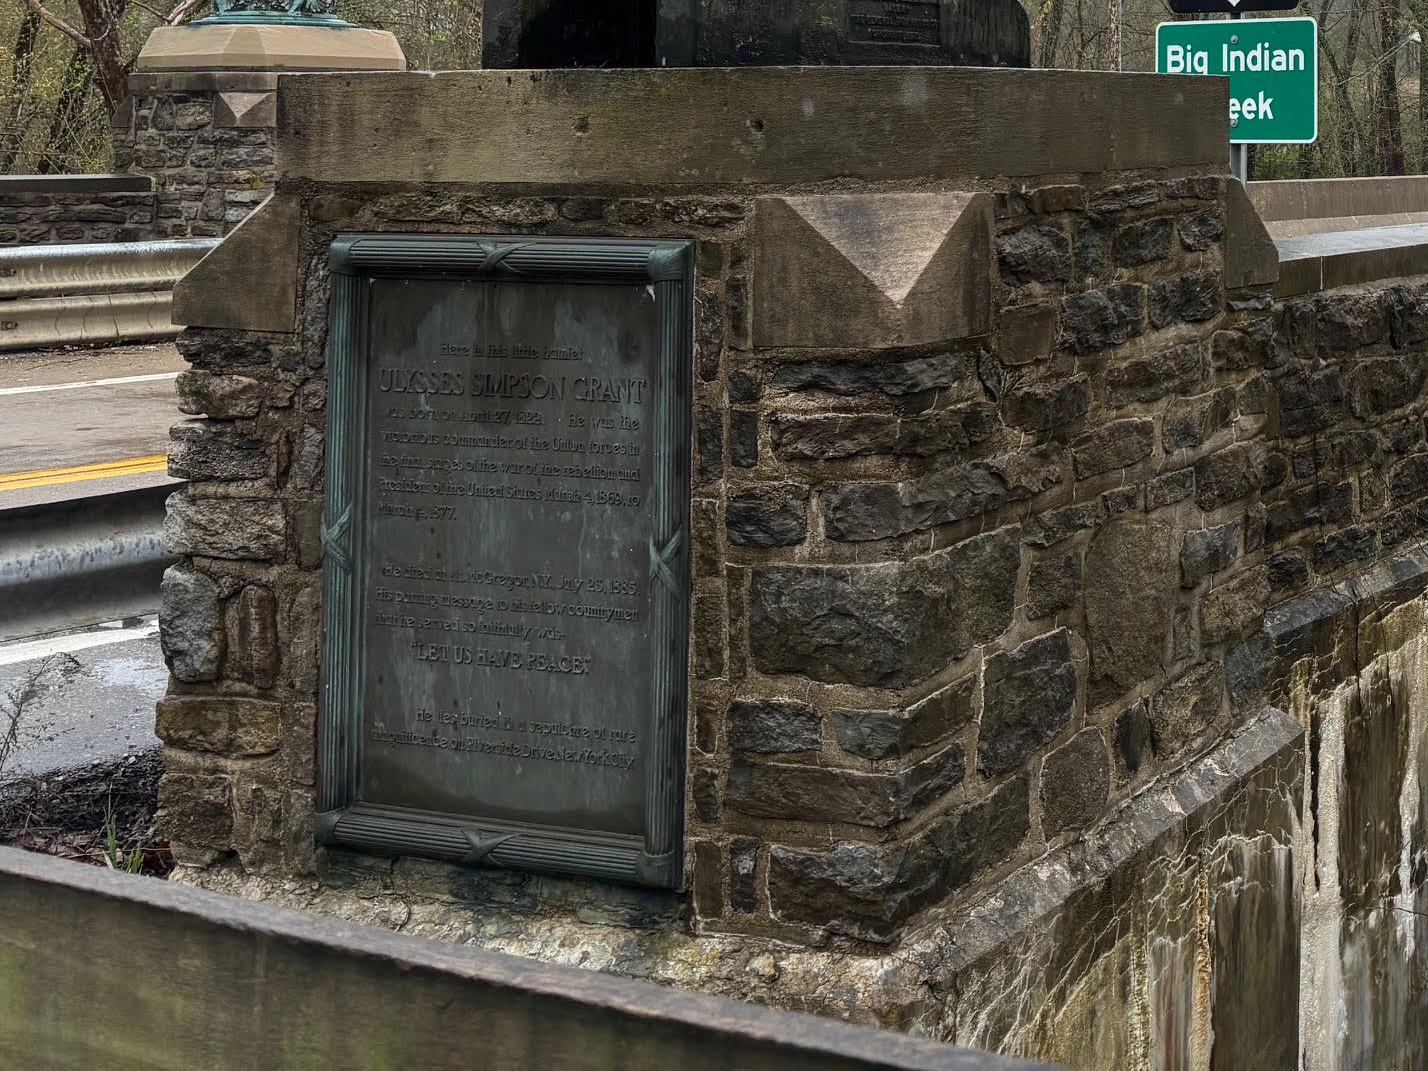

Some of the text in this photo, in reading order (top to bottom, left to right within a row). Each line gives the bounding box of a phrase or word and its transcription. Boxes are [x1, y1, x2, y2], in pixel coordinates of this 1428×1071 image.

[1167, 41, 1305, 76] Big Indian
[1229, 90, 1274, 120] eek
[379, 369, 647, 404] ULYSSES SIMPSON GRANT
[568, 413, 585, 429] He
[590, 416, 616, 430] was
[619, 415, 640, 431] the
[453, 645, 472, 664] US
[476, 647, 522, 670] HAVE
